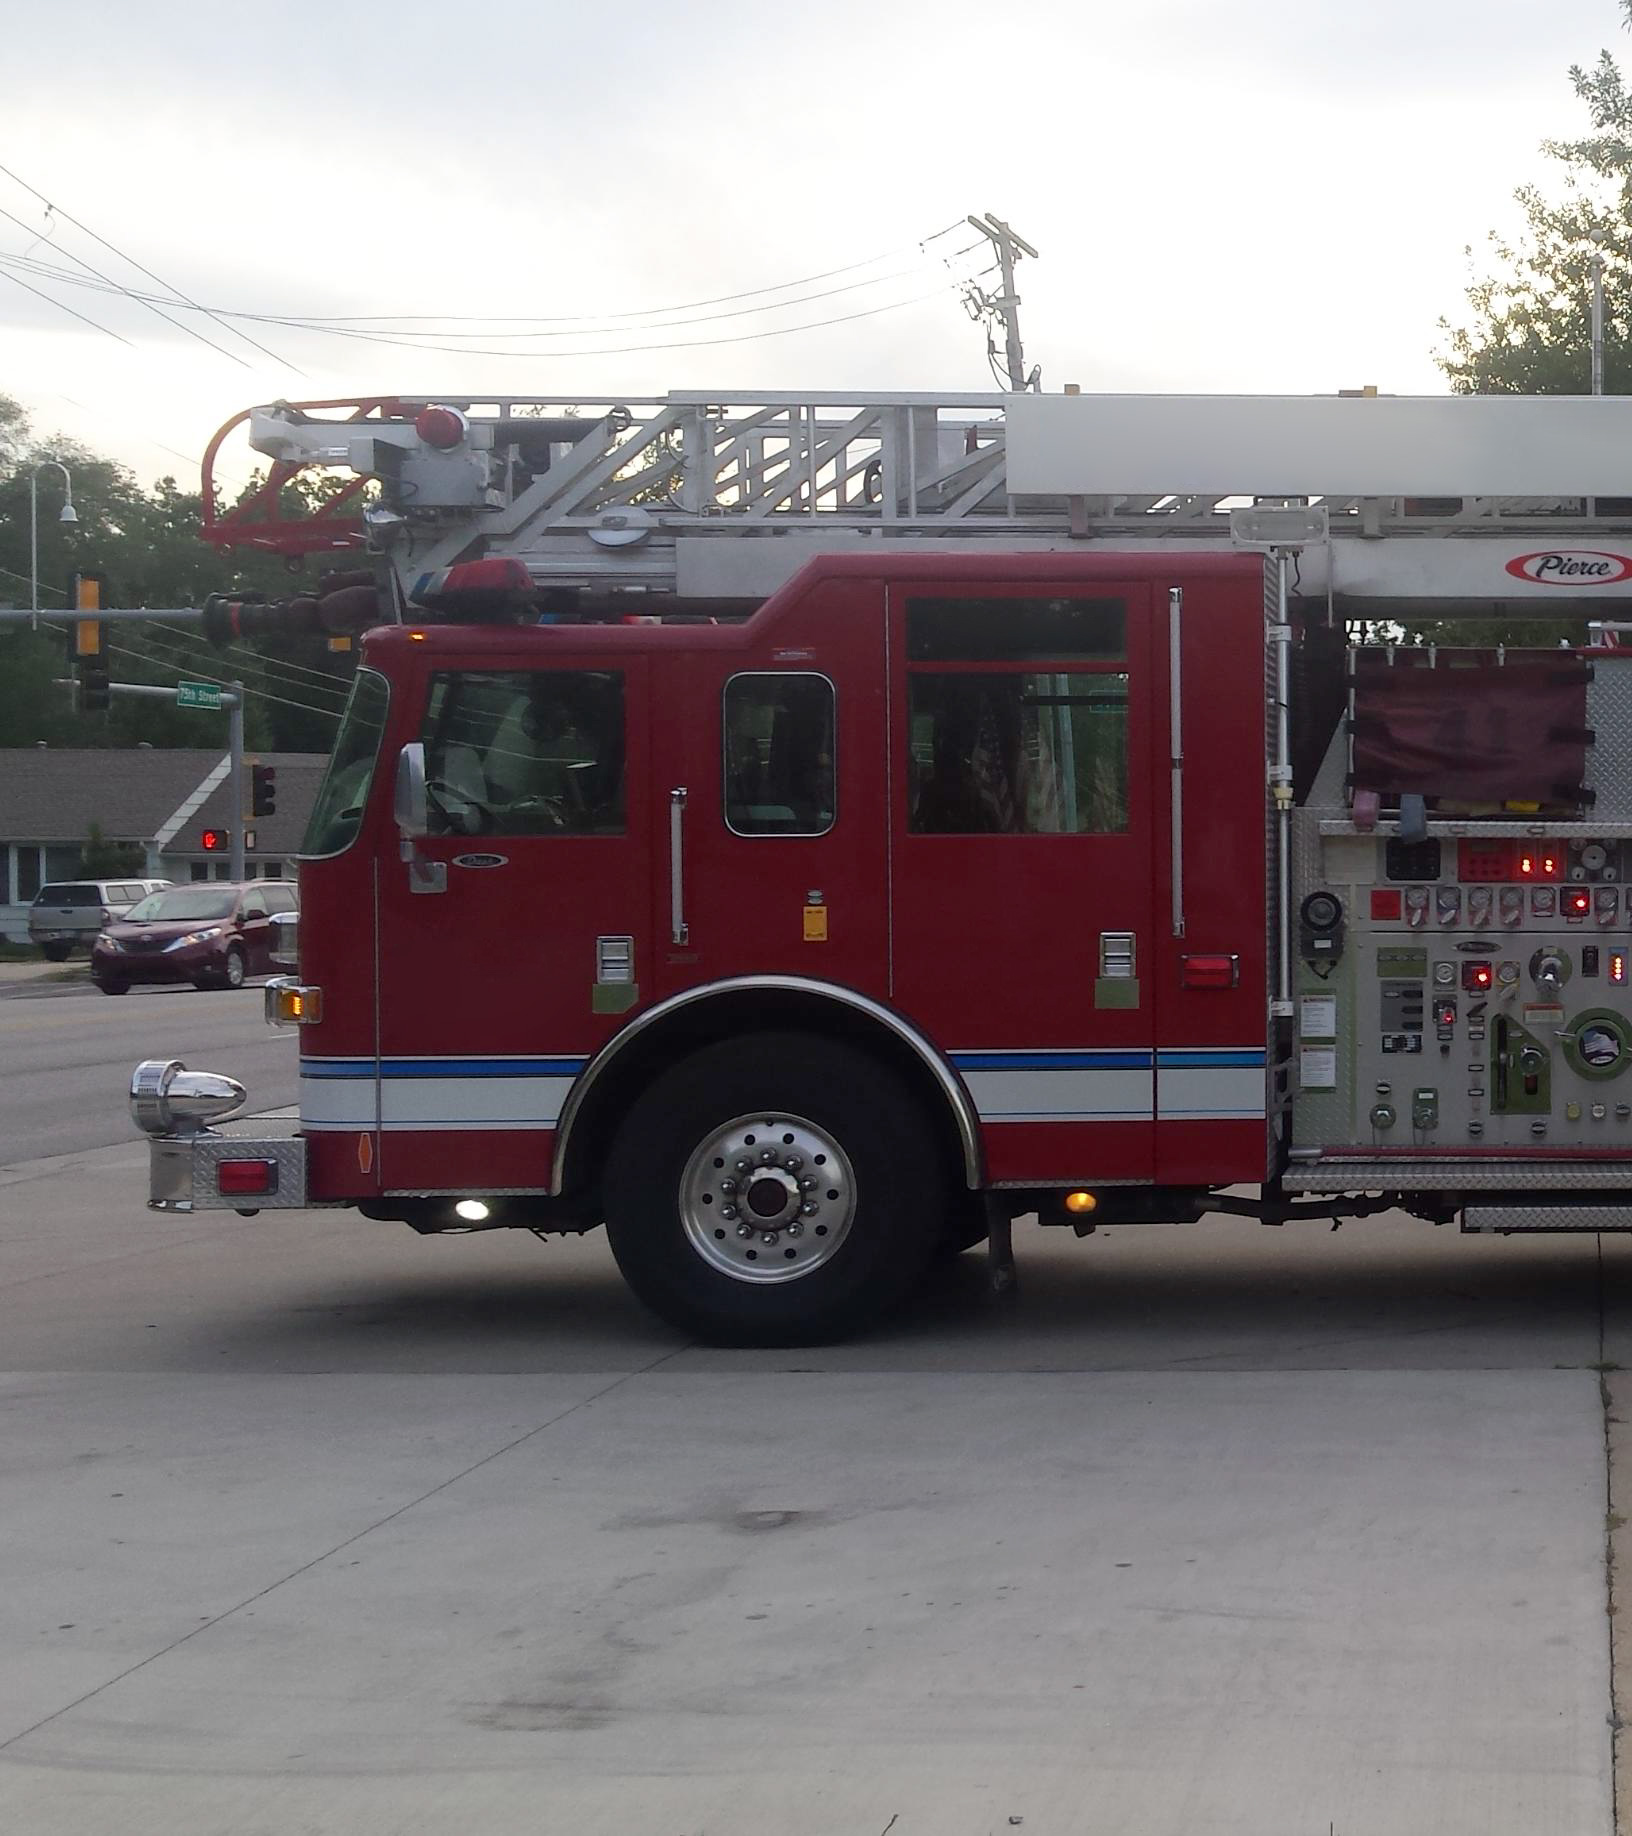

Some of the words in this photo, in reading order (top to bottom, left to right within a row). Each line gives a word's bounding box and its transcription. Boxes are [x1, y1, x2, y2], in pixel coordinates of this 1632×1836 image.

[1535, 555, 1611, 578] Pierce
[180, 687, 196, 701] 75th
[199, 690, 219, 703] Street
